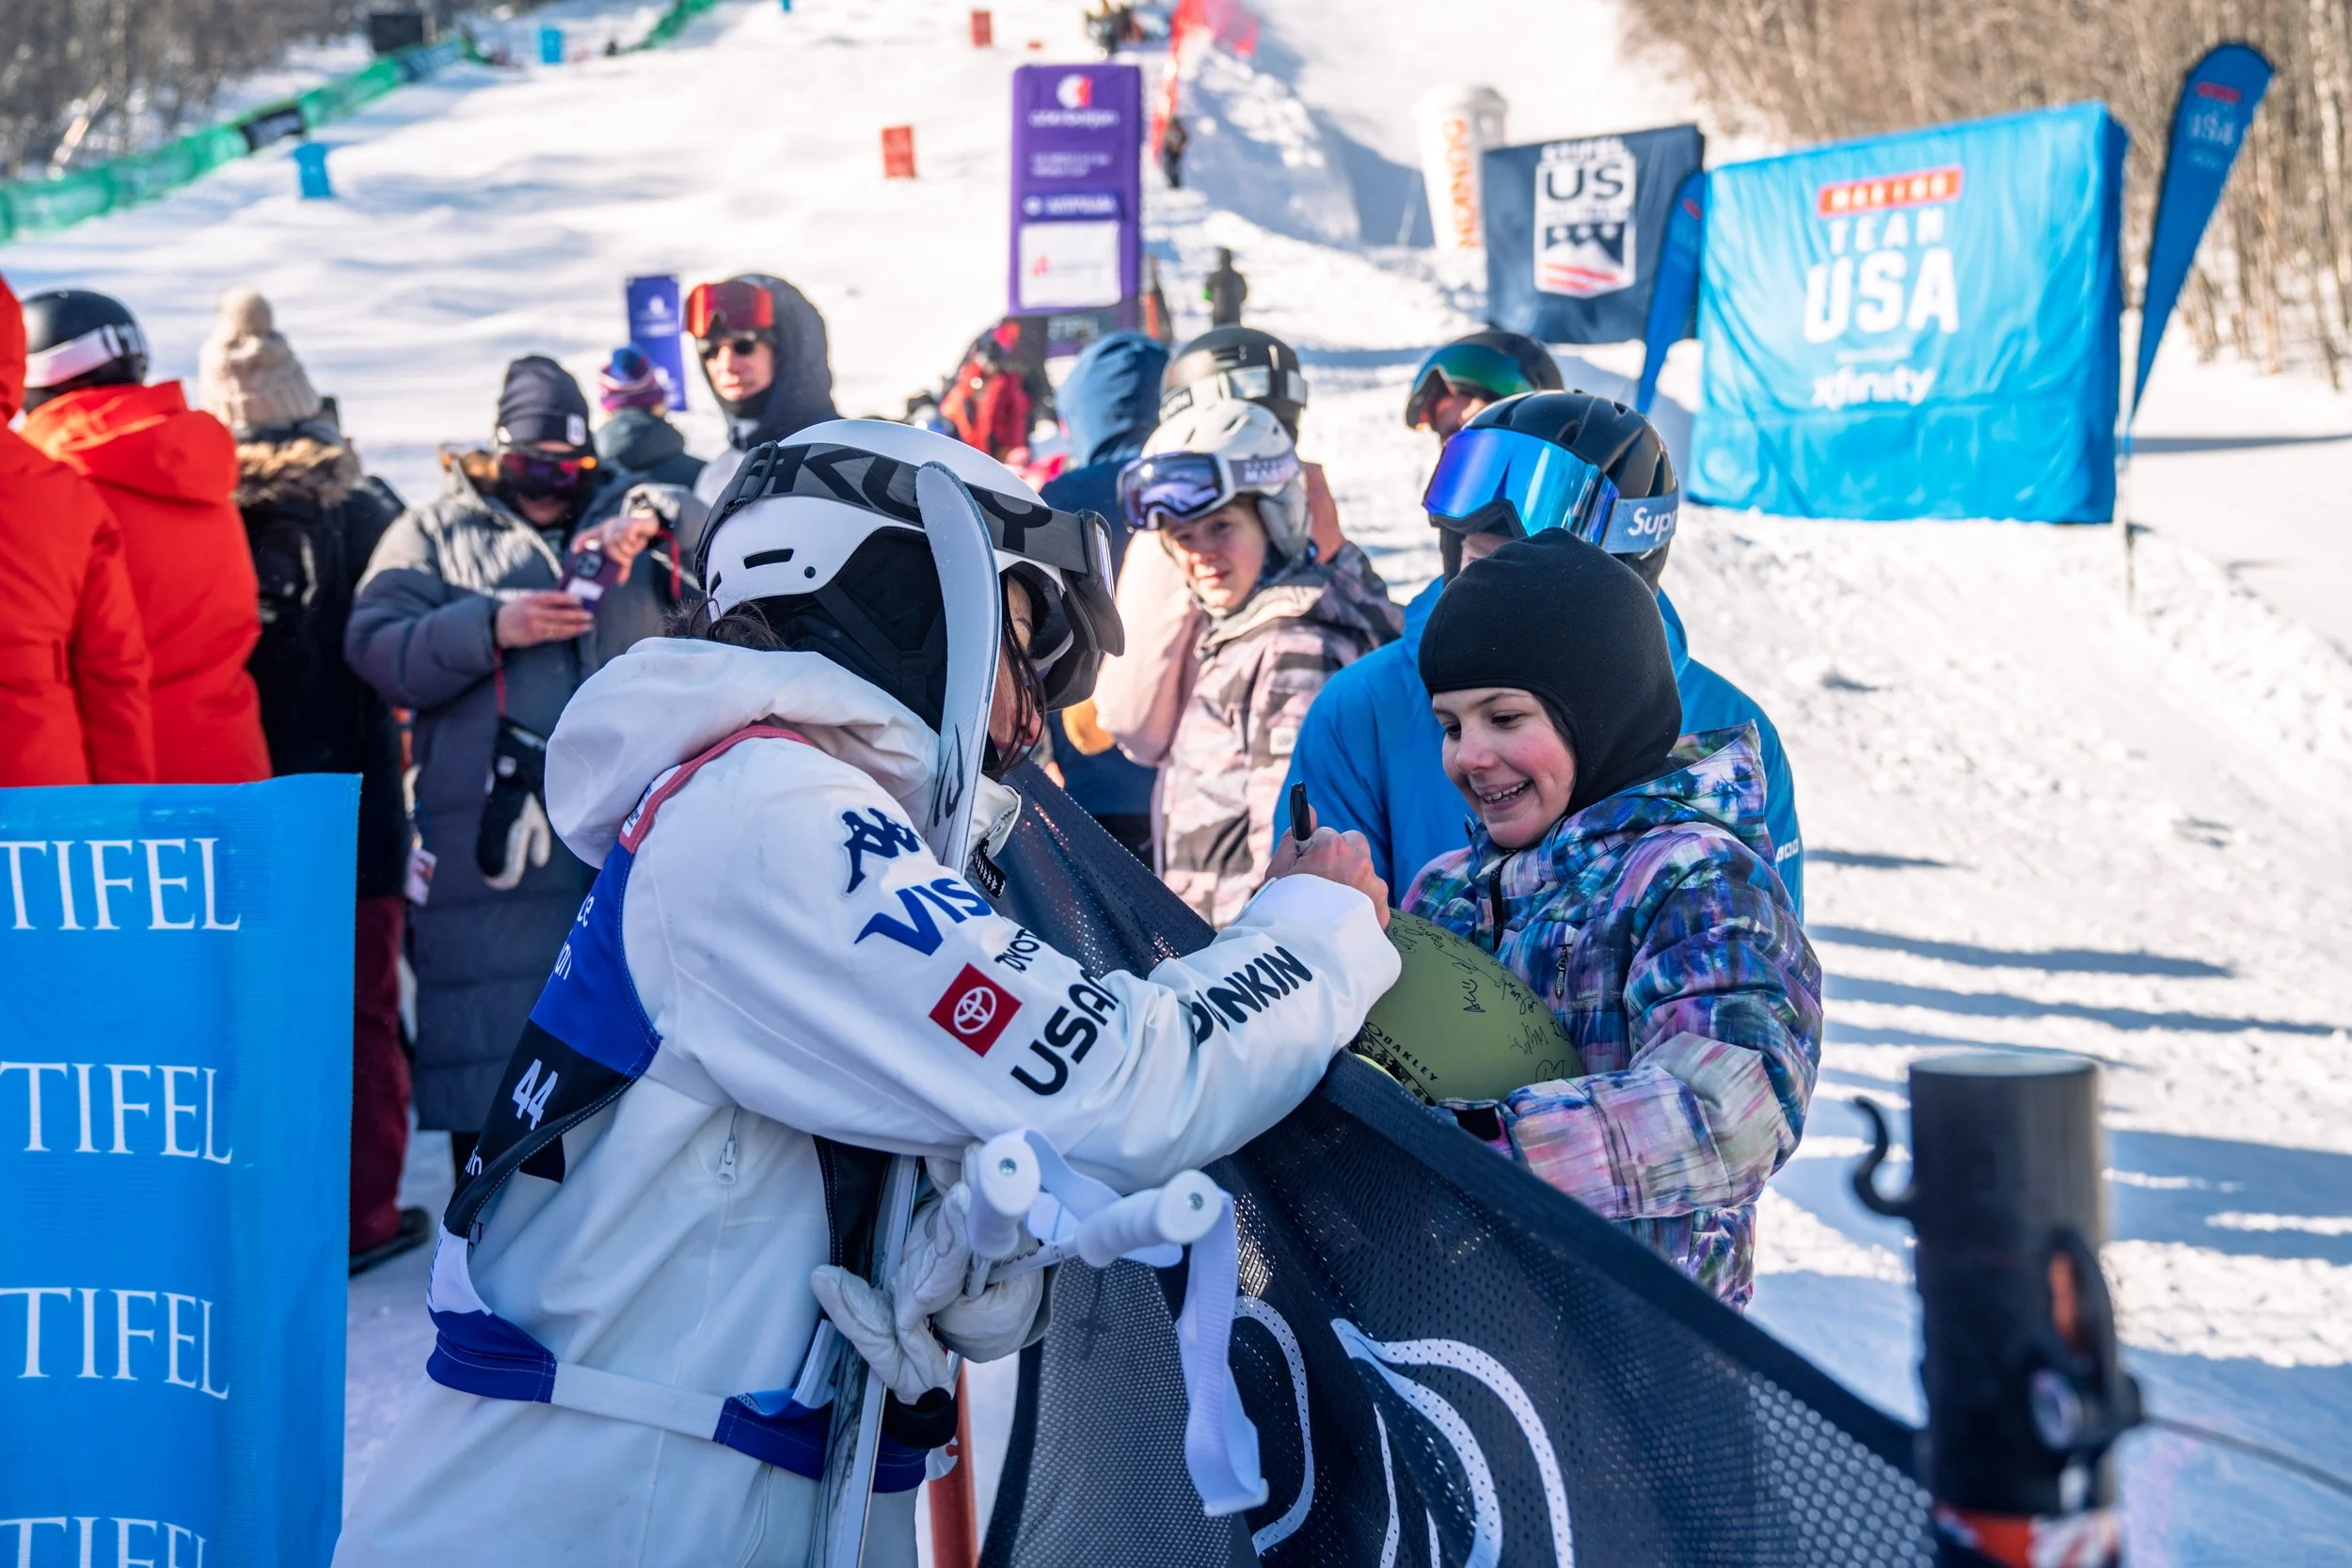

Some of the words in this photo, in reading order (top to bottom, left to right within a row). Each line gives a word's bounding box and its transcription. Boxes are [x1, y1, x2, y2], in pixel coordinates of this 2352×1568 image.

[1546, 162, 1624, 201] US
[1829, 206, 1945, 255] TEAM
[1803, 246, 1960, 344] USA
[1812, 363, 1936, 412] xfinity
[854, 877, 993, 957] VIS
[512, 1058, 559, 1131] 44
[1382, 1035, 1439, 1083] OAKLEY
[0, 1060, 233, 1164] TIFEL
[0, 1286, 230, 1400] TIFEL
